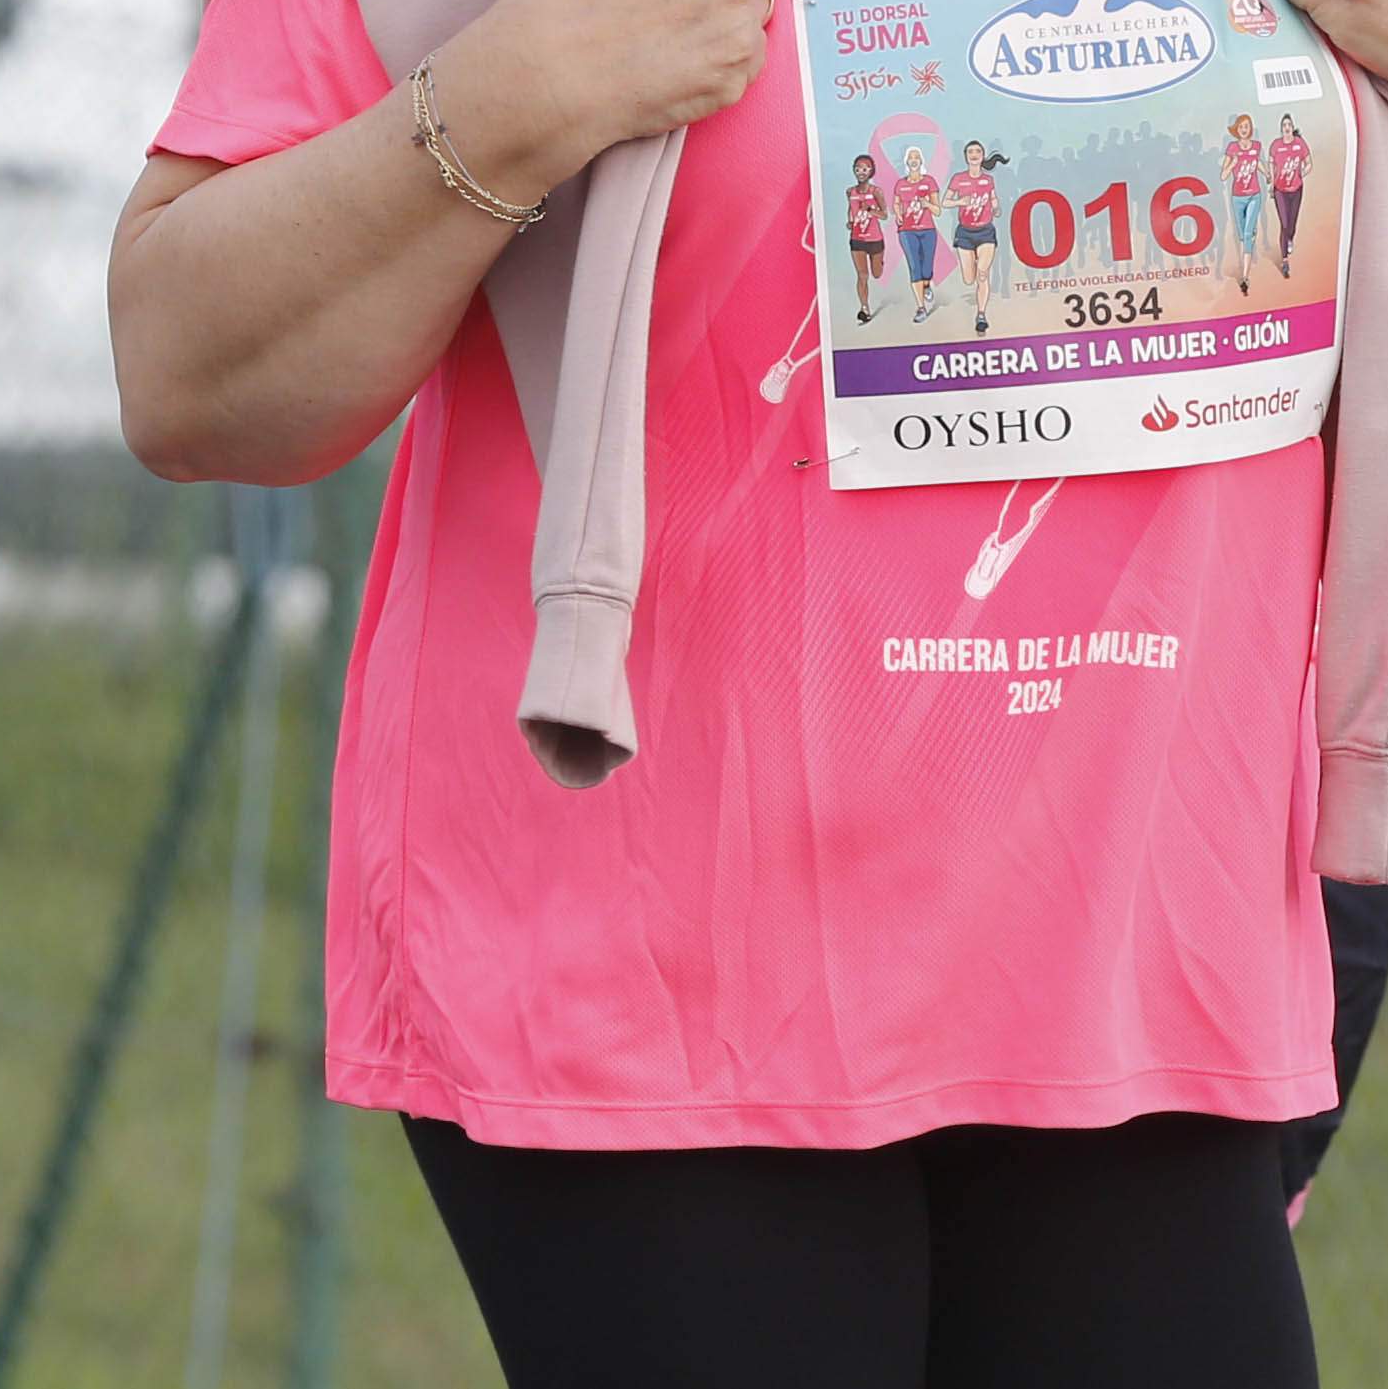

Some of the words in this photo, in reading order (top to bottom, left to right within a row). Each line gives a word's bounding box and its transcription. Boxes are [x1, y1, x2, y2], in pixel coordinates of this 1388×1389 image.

[831, 10, 855, 26] TU
[859, 2, 930, 24] DORSAL
[1024, 22, 1105, 40] CENTRAL
[1112, 15, 1190, 33] LECHERA
[835, 21, 931, 55] SUMA
[989, 32, 1201, 79] ASTURIANA
[834, 66, 903, 101] gijón
[1010, 175, 1216, 270] 016
[1014, 278, 1078, 293] TELÉFONO
[1079, 271, 1144, 288] VIOLENCIA
[1146, 270, 1163, 281] DE
[1164, 265, 1211, 280] GÉNERO
[1063, 286, 1163, 328] 3634
[912, 345, 1039, 382] CARRERA
[1045, 341, 1082, 371] DE
[1088, 338, 1124, 367] LA
[1131, 330, 1217, 364] MUJER
[1233, 314, 1291, 352] GIJÓN
[894, 404, 1072, 450] OYSHO
[1184, 386, 1301, 429] Santander
[882, 636, 1010, 672] CARRERA
[1017, 637, 1051, 671] DE
[1056, 634, 1081, 669] LA
[1086, 630, 1179, 669] MUJER
[1007, 677, 1063, 716] 2024
